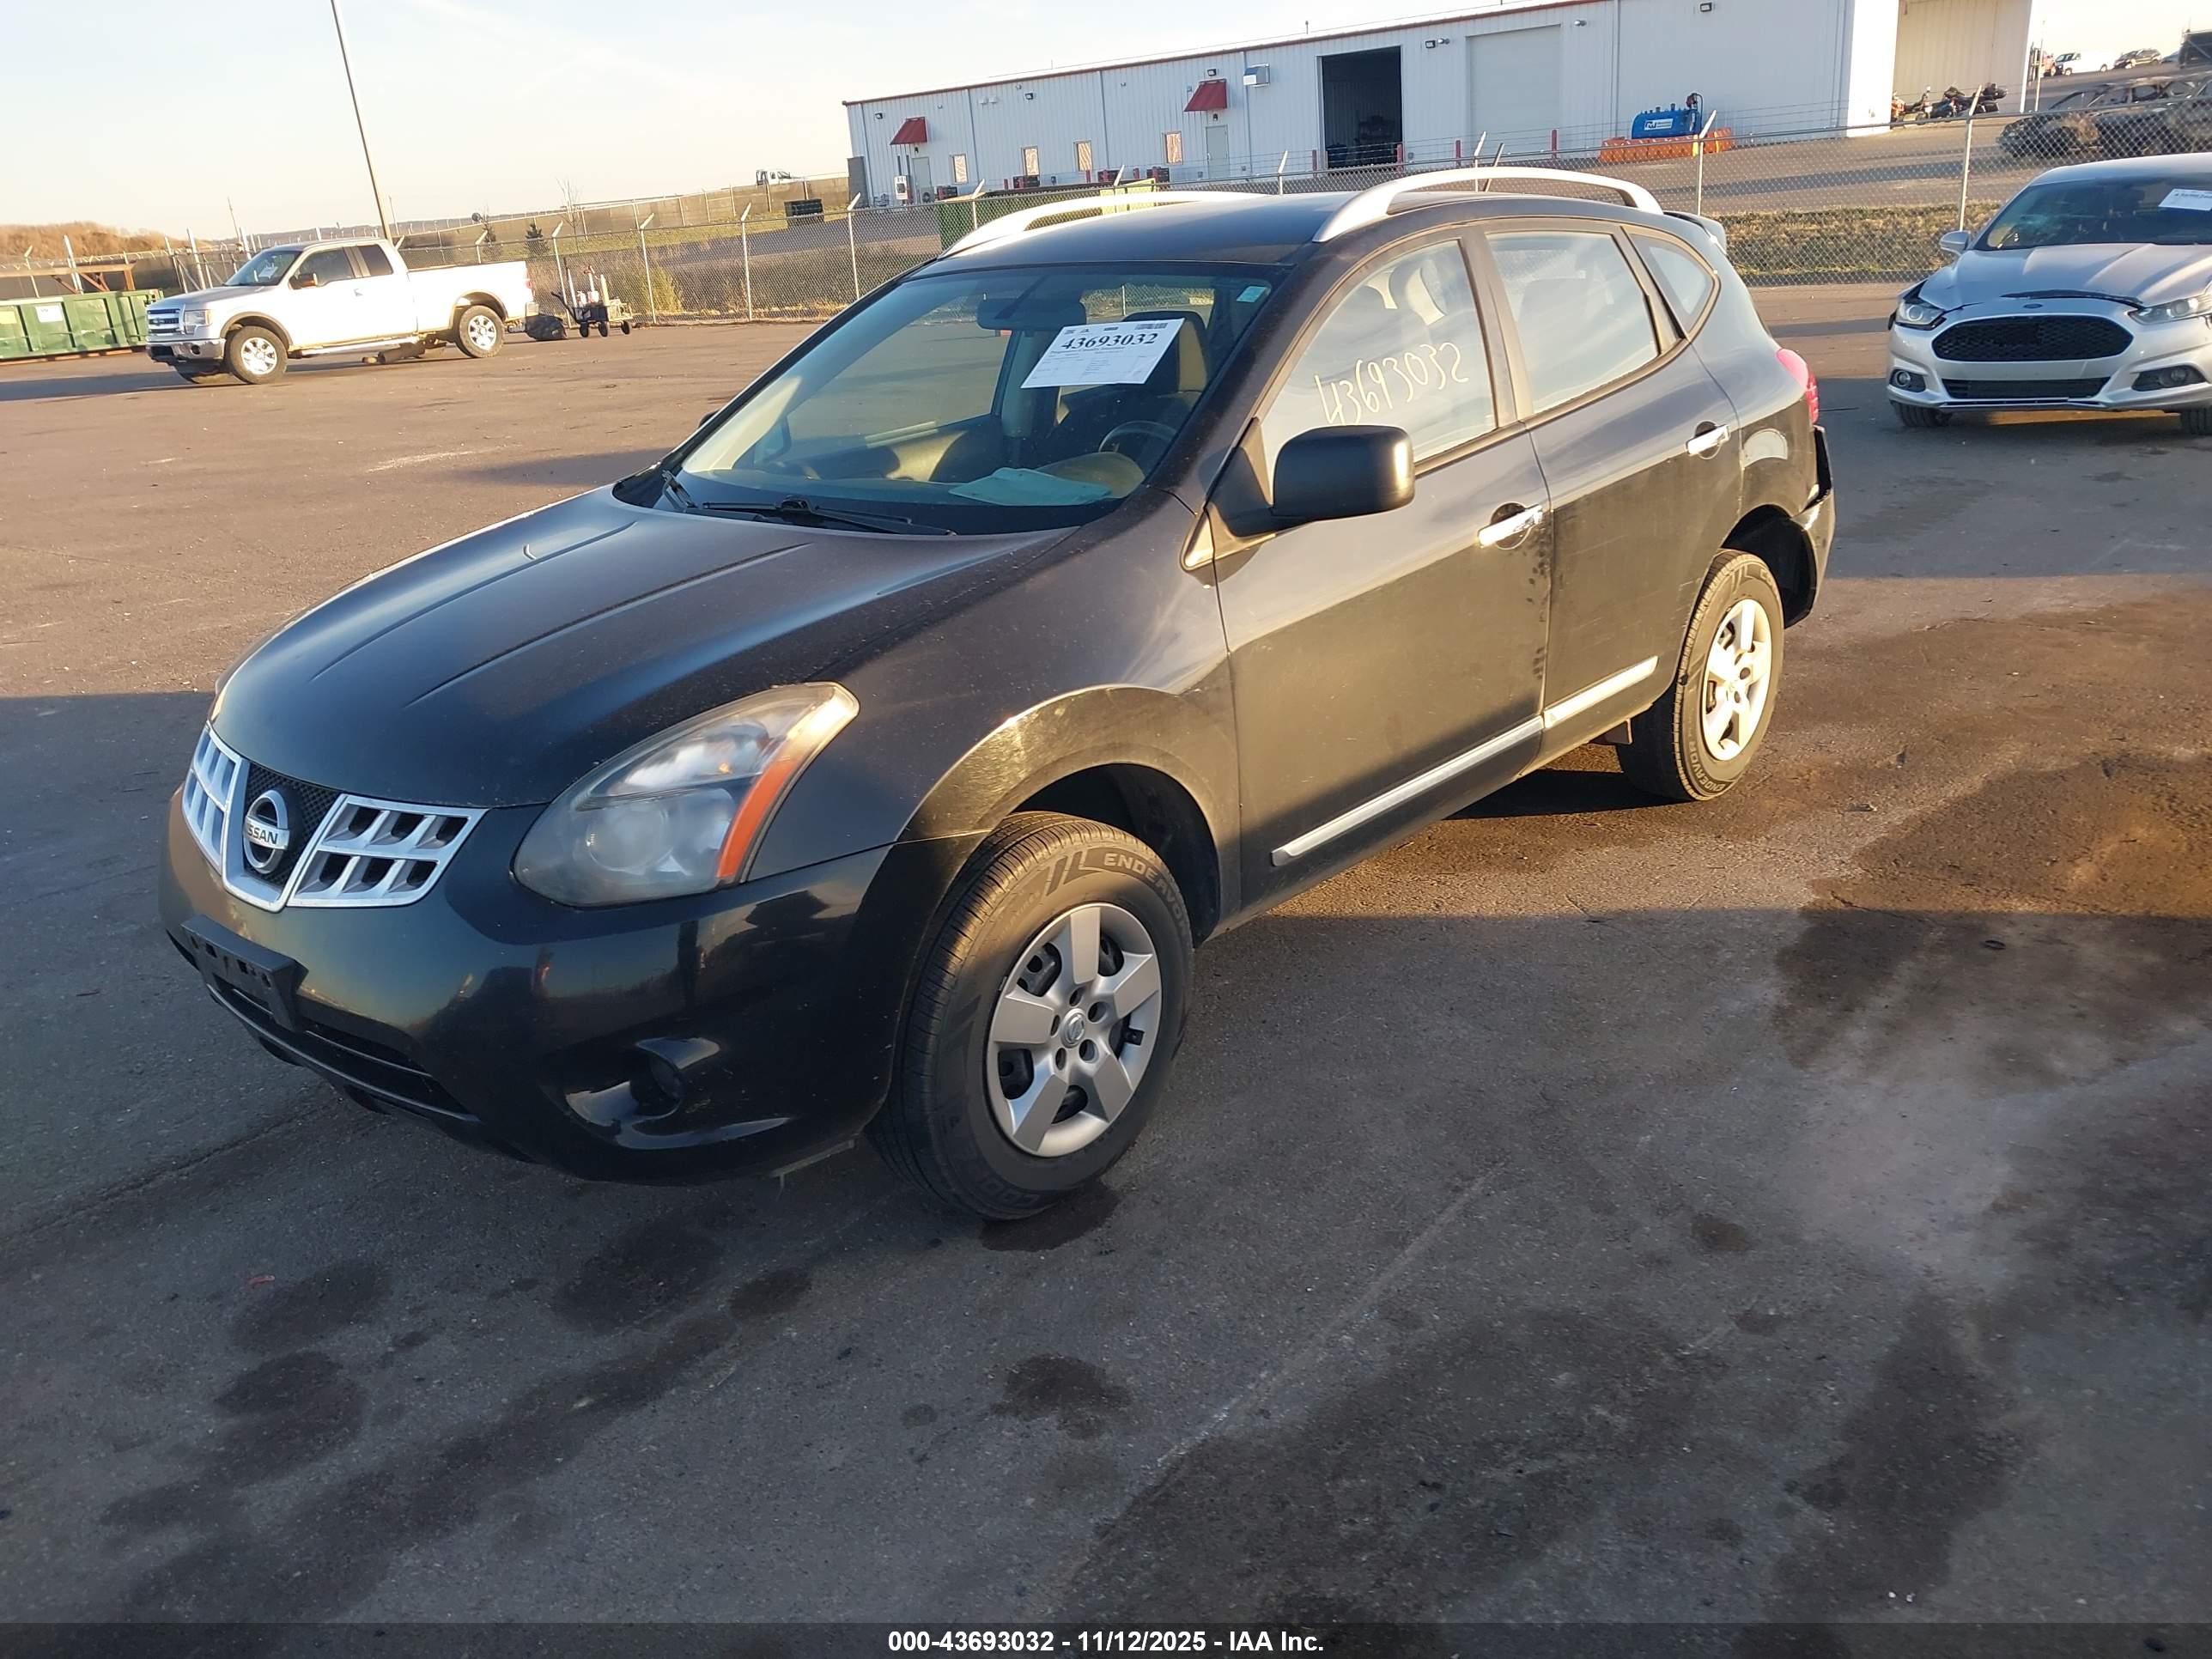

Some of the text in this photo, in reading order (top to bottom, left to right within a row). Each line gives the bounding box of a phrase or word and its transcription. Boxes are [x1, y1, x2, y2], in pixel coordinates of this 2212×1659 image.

[1060, 332, 1158, 350] 43693032
[1314, 342, 1469, 426] 43693032
[247, 823, 278, 845] SSAN
